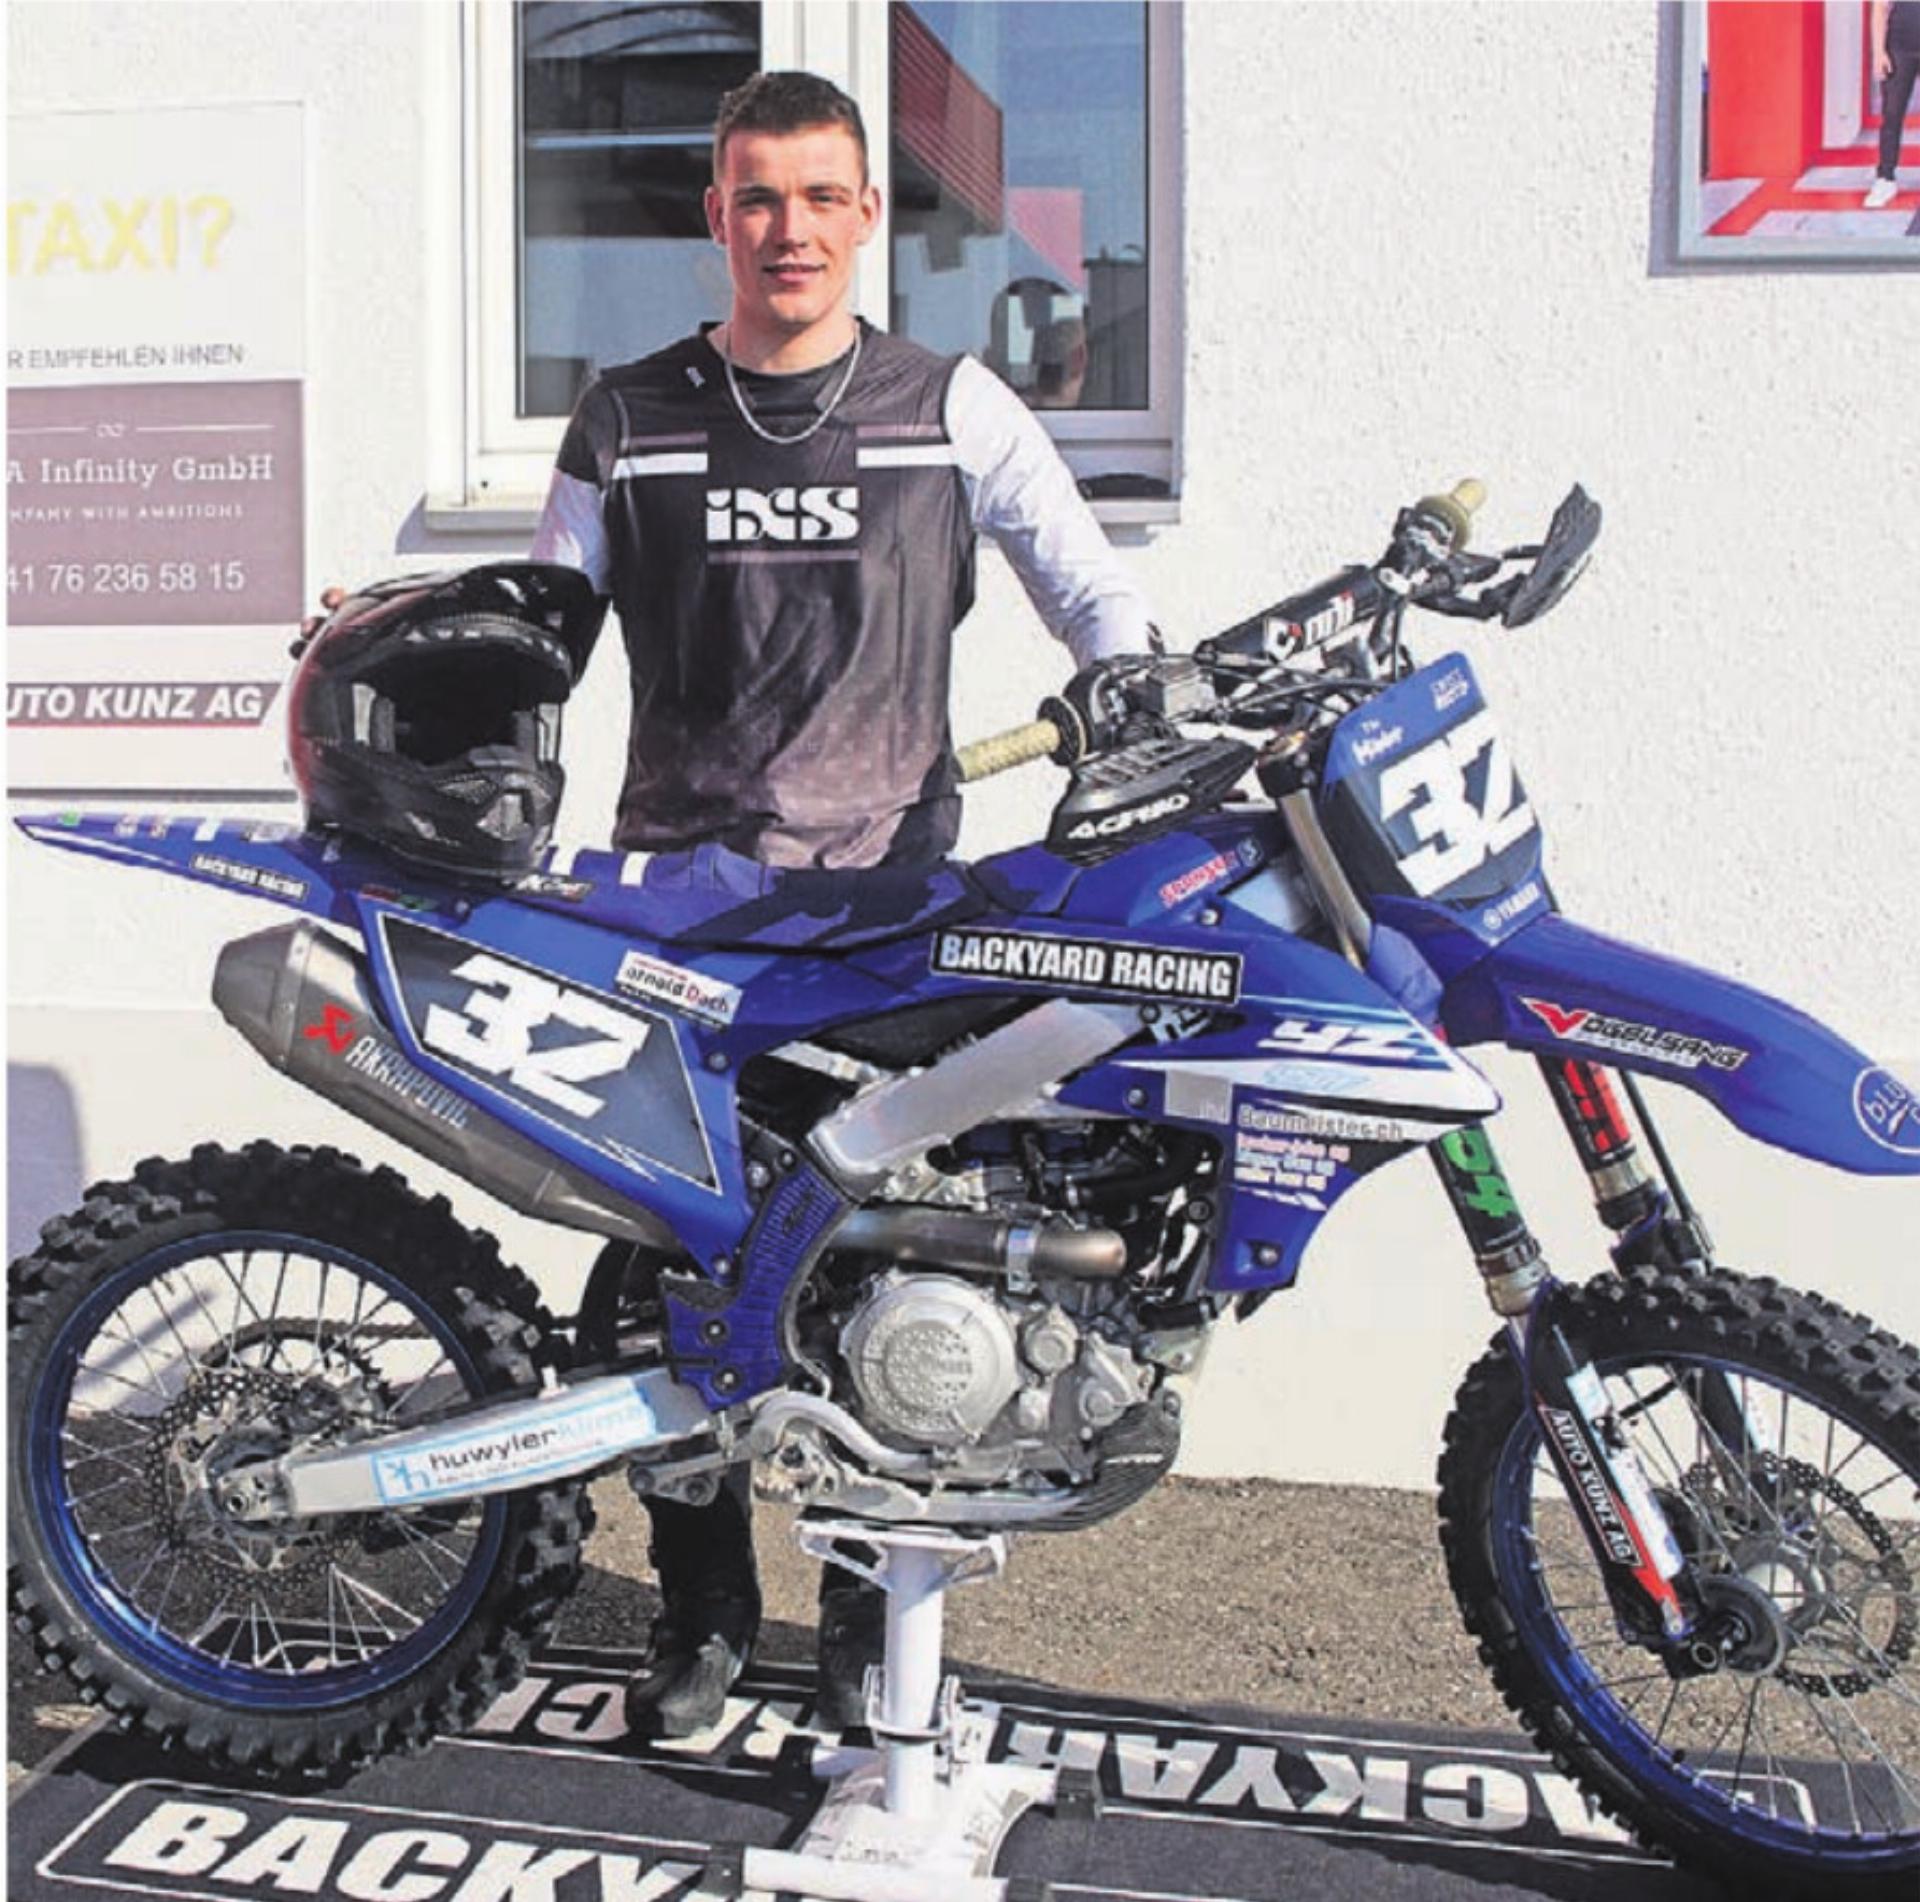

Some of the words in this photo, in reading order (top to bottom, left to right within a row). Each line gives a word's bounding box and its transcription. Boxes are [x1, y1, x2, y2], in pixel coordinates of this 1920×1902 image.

[29, 345, 166, 368] EMPFEHLEN
[173, 344, 243, 365] IHNEN
[41, 458, 157, 488] Infinity
[172, 455, 272, 481] GmbH
[138, 504, 242, 519] AMBITIONS
[48, 565, 84, 592] 76
[94, 565, 149, 592] 236
[159, 563, 197, 591] 58
[208, 561, 245, 590] 15
[84, 687, 197, 718] KUNZ
[204, 686, 263, 718] AG
[1380, 711, 1536, 897] 32
[940, 935, 1107, 982] BACKYARD
[1110, 951, 1231, 996] RACING
[424, 953, 651, 1119] 32
[1551, 1413, 1588, 1466] AUTO
[1578, 1470, 1619, 1524] KUNZ
[1605, 1530, 1633, 1560] AG
